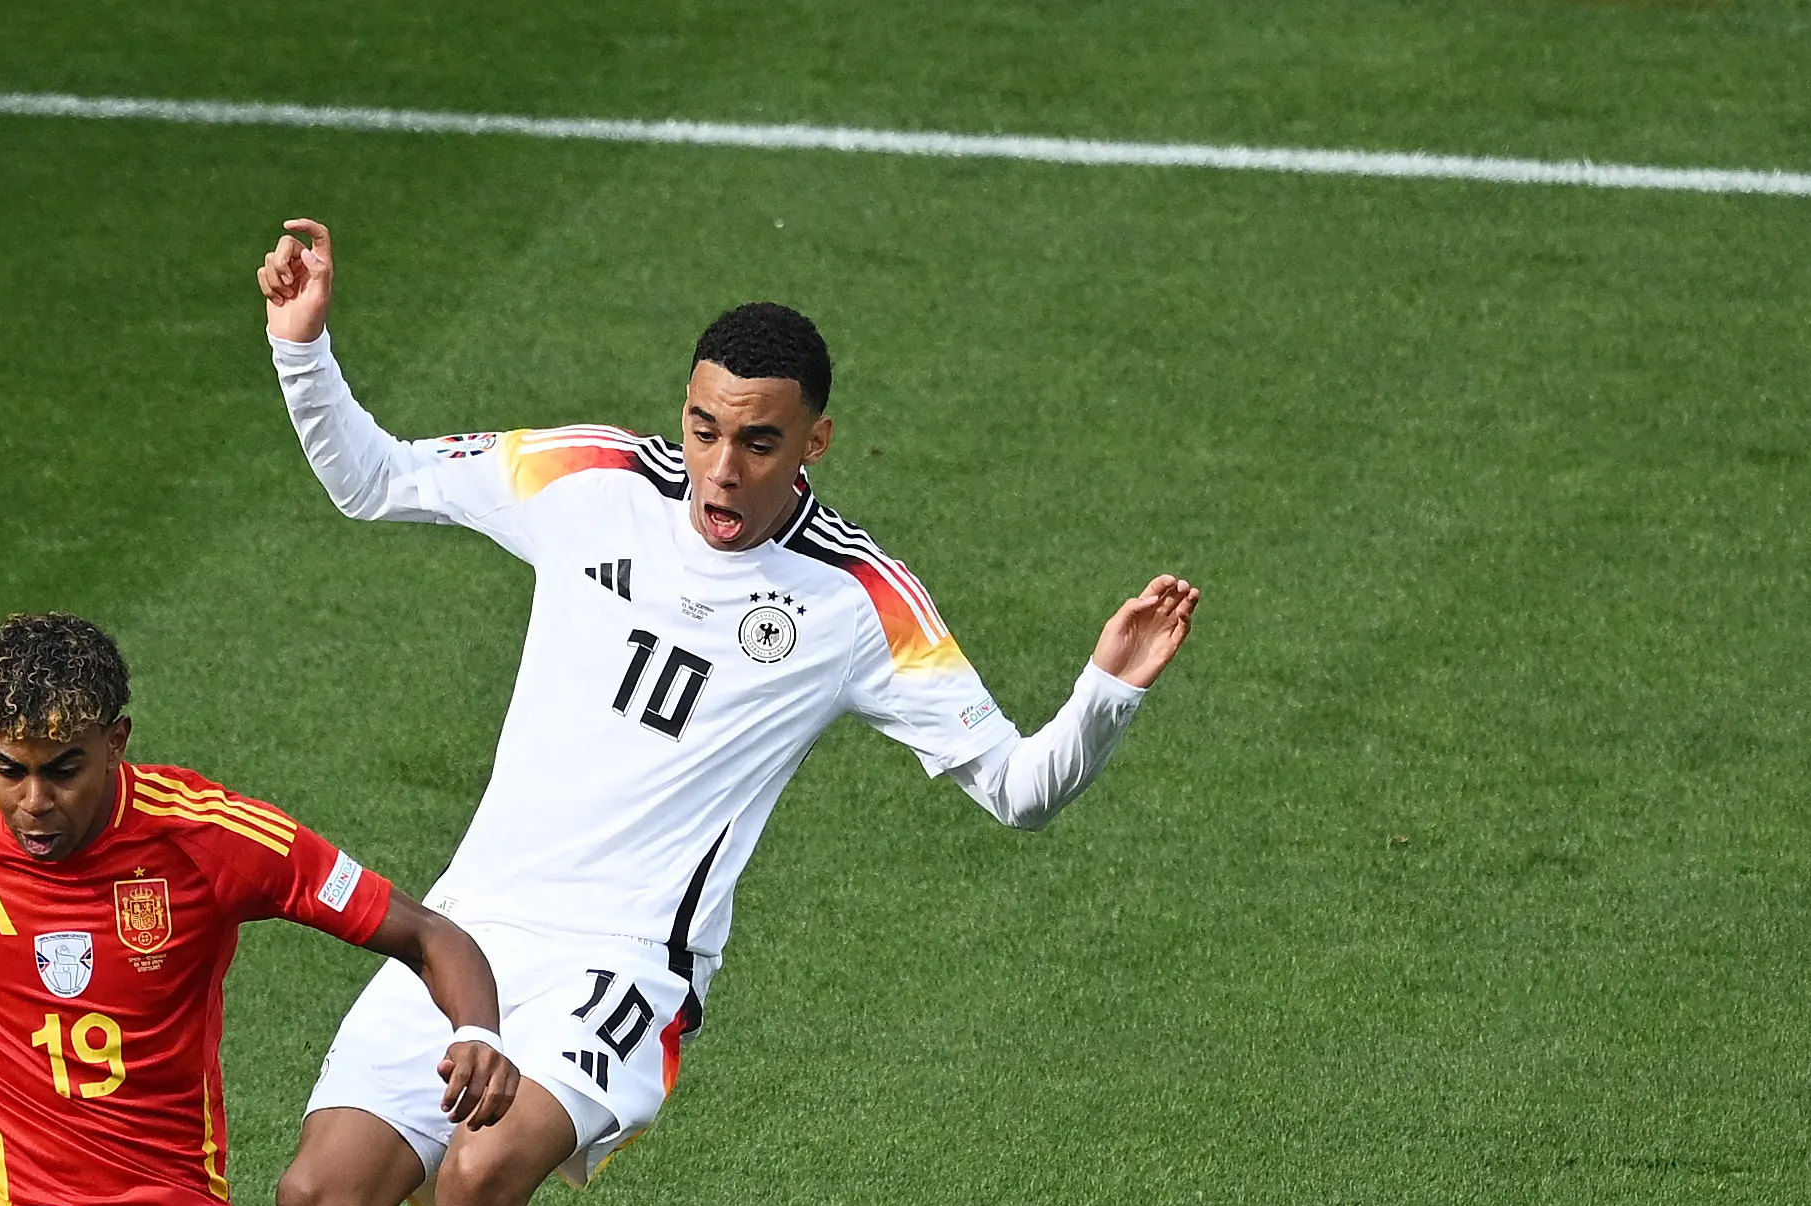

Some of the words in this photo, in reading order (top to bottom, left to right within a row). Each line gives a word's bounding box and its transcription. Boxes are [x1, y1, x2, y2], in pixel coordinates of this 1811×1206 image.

[612, 629, 714, 742] 10
[32, 1012, 126, 1099] 19
[571, 968, 656, 1065] 10
